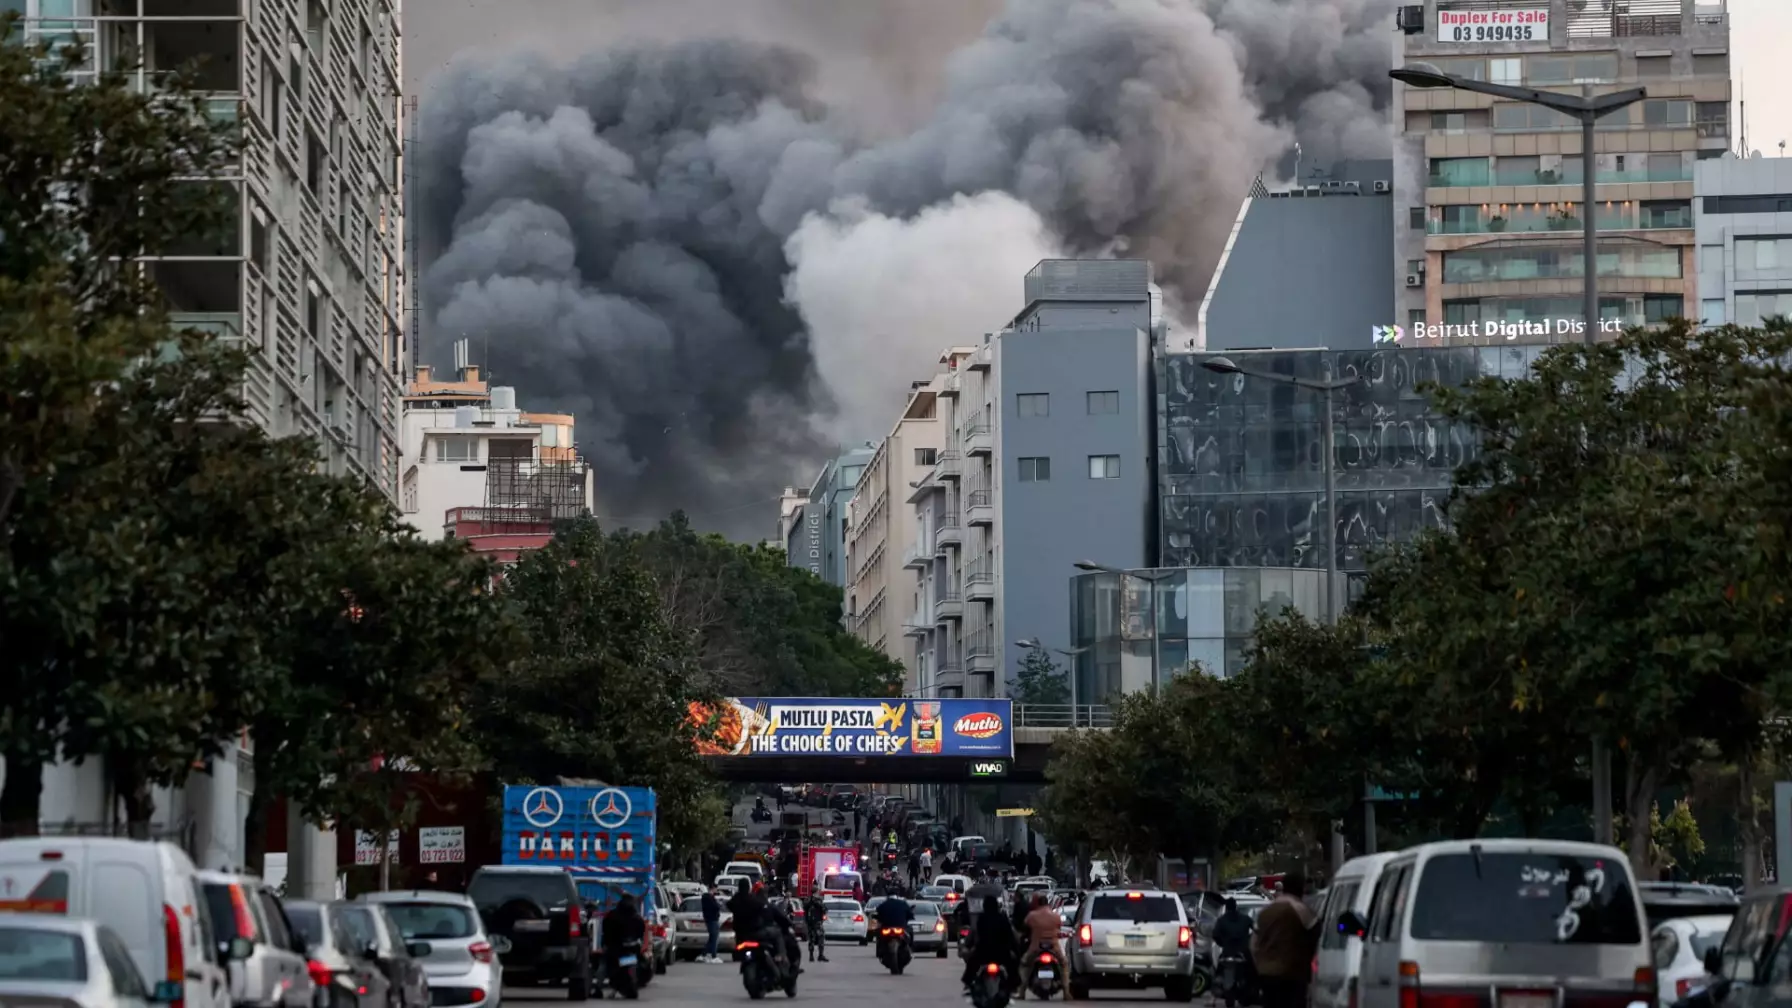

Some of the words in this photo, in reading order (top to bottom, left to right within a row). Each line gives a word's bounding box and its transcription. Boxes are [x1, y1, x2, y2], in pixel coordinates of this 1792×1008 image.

[1442, 11, 1488, 26] Duplex
[1492, 11, 1513, 23] For
[1517, 10, 1546, 23] Sale
[1453, 26, 1471, 41] 03
[1476, 26, 1532, 40] 949435
[1414, 321, 1479, 338] Beirut
[1485, 318, 1550, 340] Digital
[1557, 317, 1622, 335] Disict
[809, 512, 819, 558] District
[780, 710, 827, 726] MUTLU
[832, 710, 874, 726] PASTA
[954, 716, 999, 732] Mutlu
[751, 735, 777, 752] THE
[781, 735, 831, 752] CHOICE
[835, 735, 853, 752] OF
[857, 735, 899, 752] CHEFS
[975, 763, 1003, 773] VIVAD
